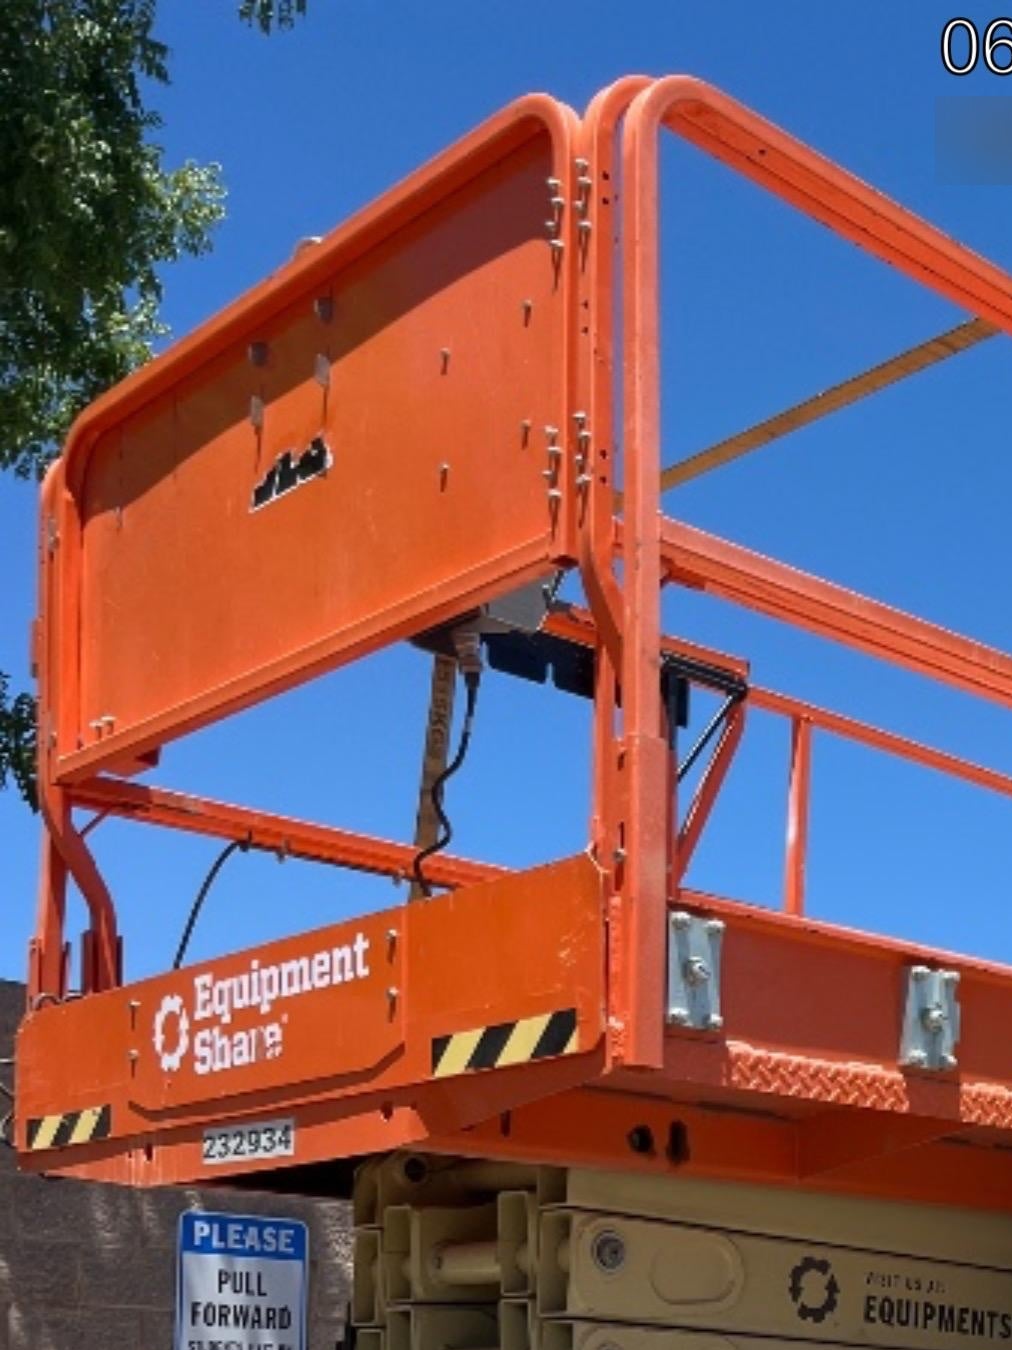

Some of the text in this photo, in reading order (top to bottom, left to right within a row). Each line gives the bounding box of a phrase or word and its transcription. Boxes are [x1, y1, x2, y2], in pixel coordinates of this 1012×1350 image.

[194, 932, 370, 1024] Equipment
[194, 1022, 282, 1075] Share
[202, 1124, 292, 1159] 232934
[193, 1220, 296, 1254] PLEASE
[217, 1268, 268, 1297] PULL
[190, 1301, 292, 1330] FORWARD
